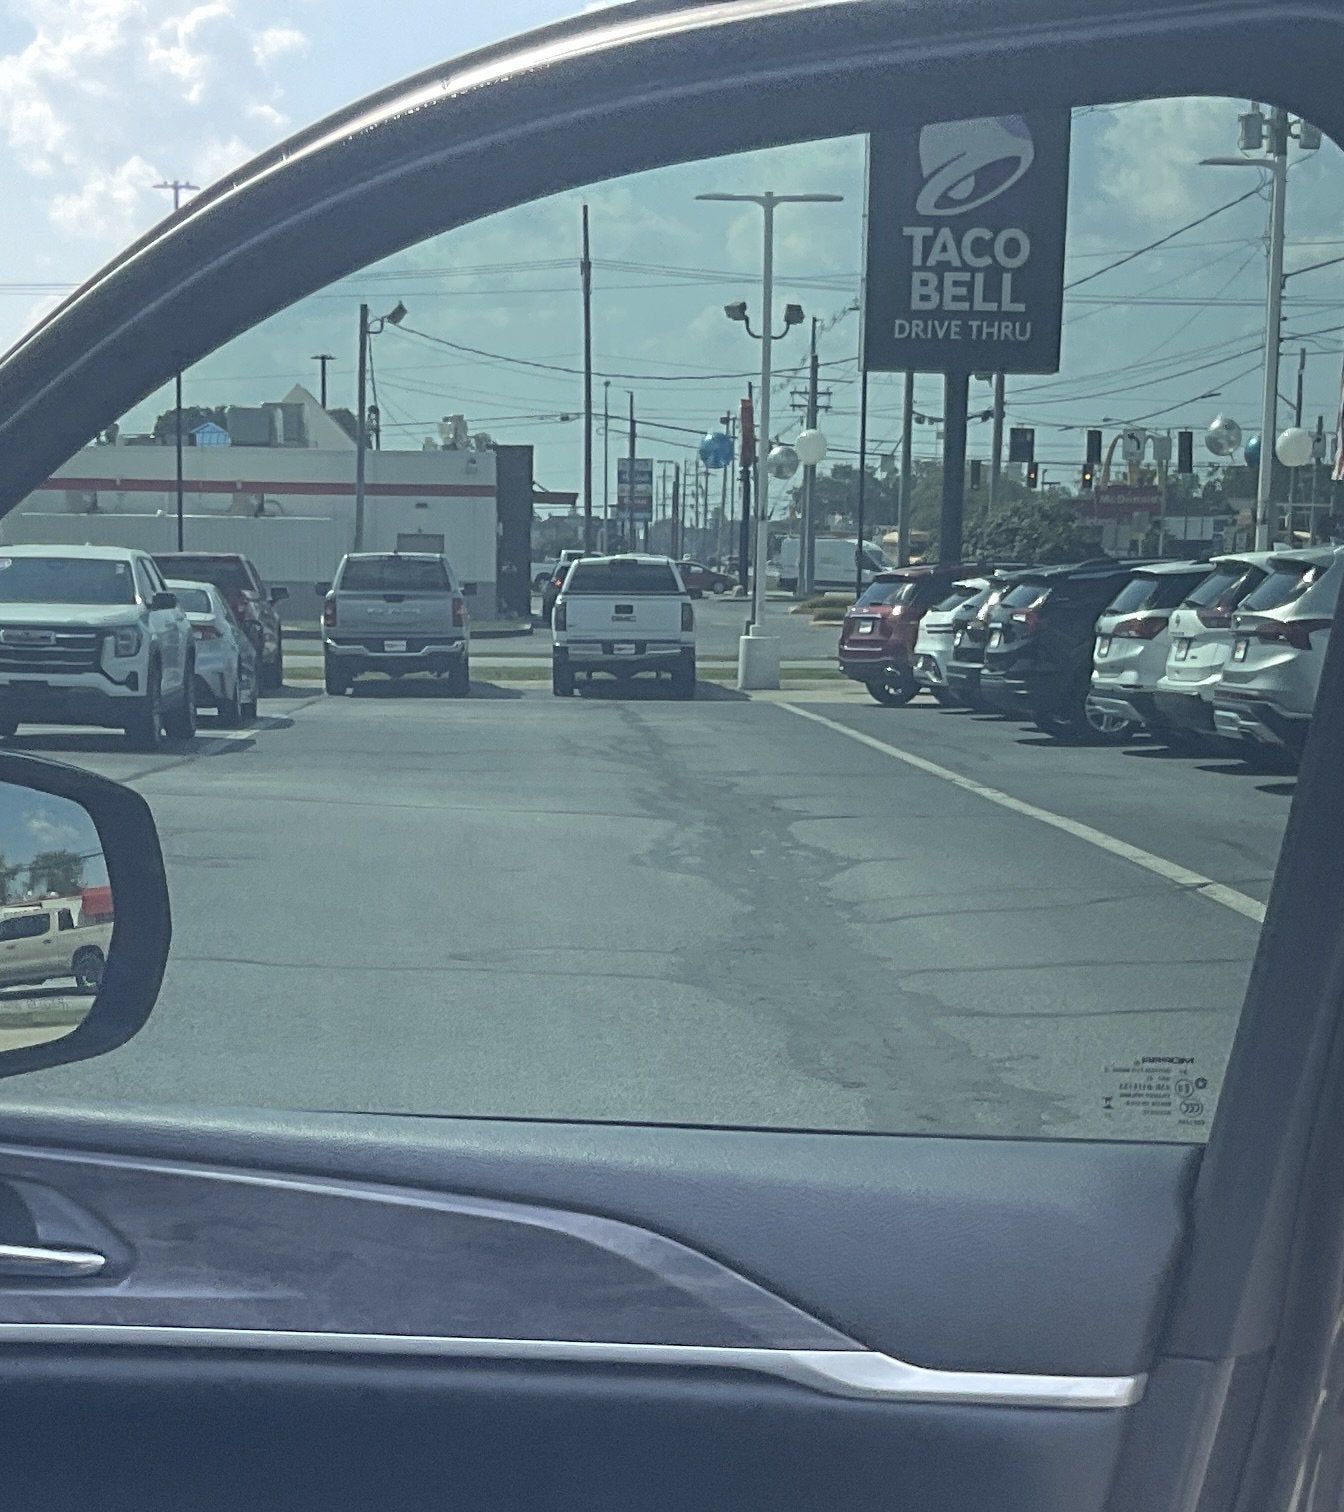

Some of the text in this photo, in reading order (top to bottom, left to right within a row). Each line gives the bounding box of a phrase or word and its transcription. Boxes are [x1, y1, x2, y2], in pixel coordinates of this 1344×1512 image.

[902, 226, 1030, 269] TACO
[910, 271, 1026, 312] BELL
[894, 319, 1031, 341] DRIVE THRU
